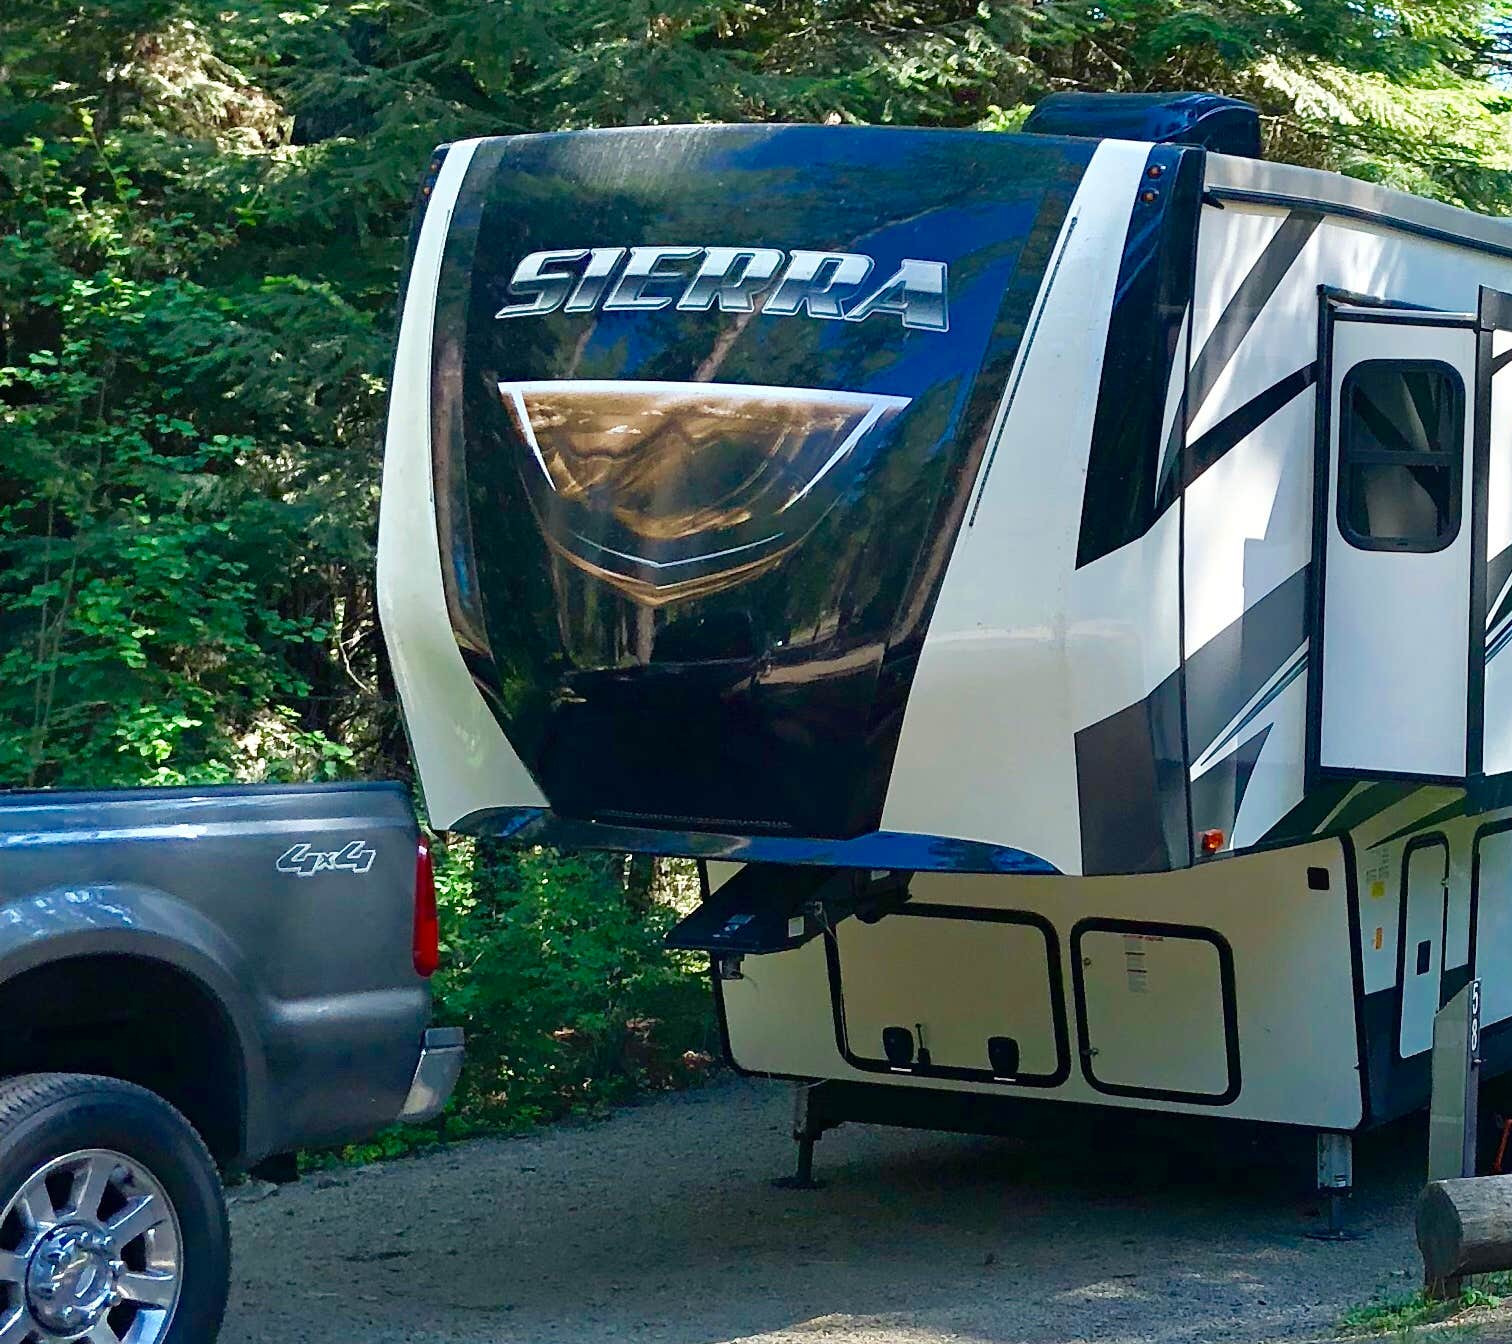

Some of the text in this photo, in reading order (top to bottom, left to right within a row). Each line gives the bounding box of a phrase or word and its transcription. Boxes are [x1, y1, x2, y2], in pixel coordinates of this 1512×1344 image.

[495, 246, 949, 332] SIERRA
[275, 841, 377, 876] 4x4
[1470, 981, 1480, 1051] 58
